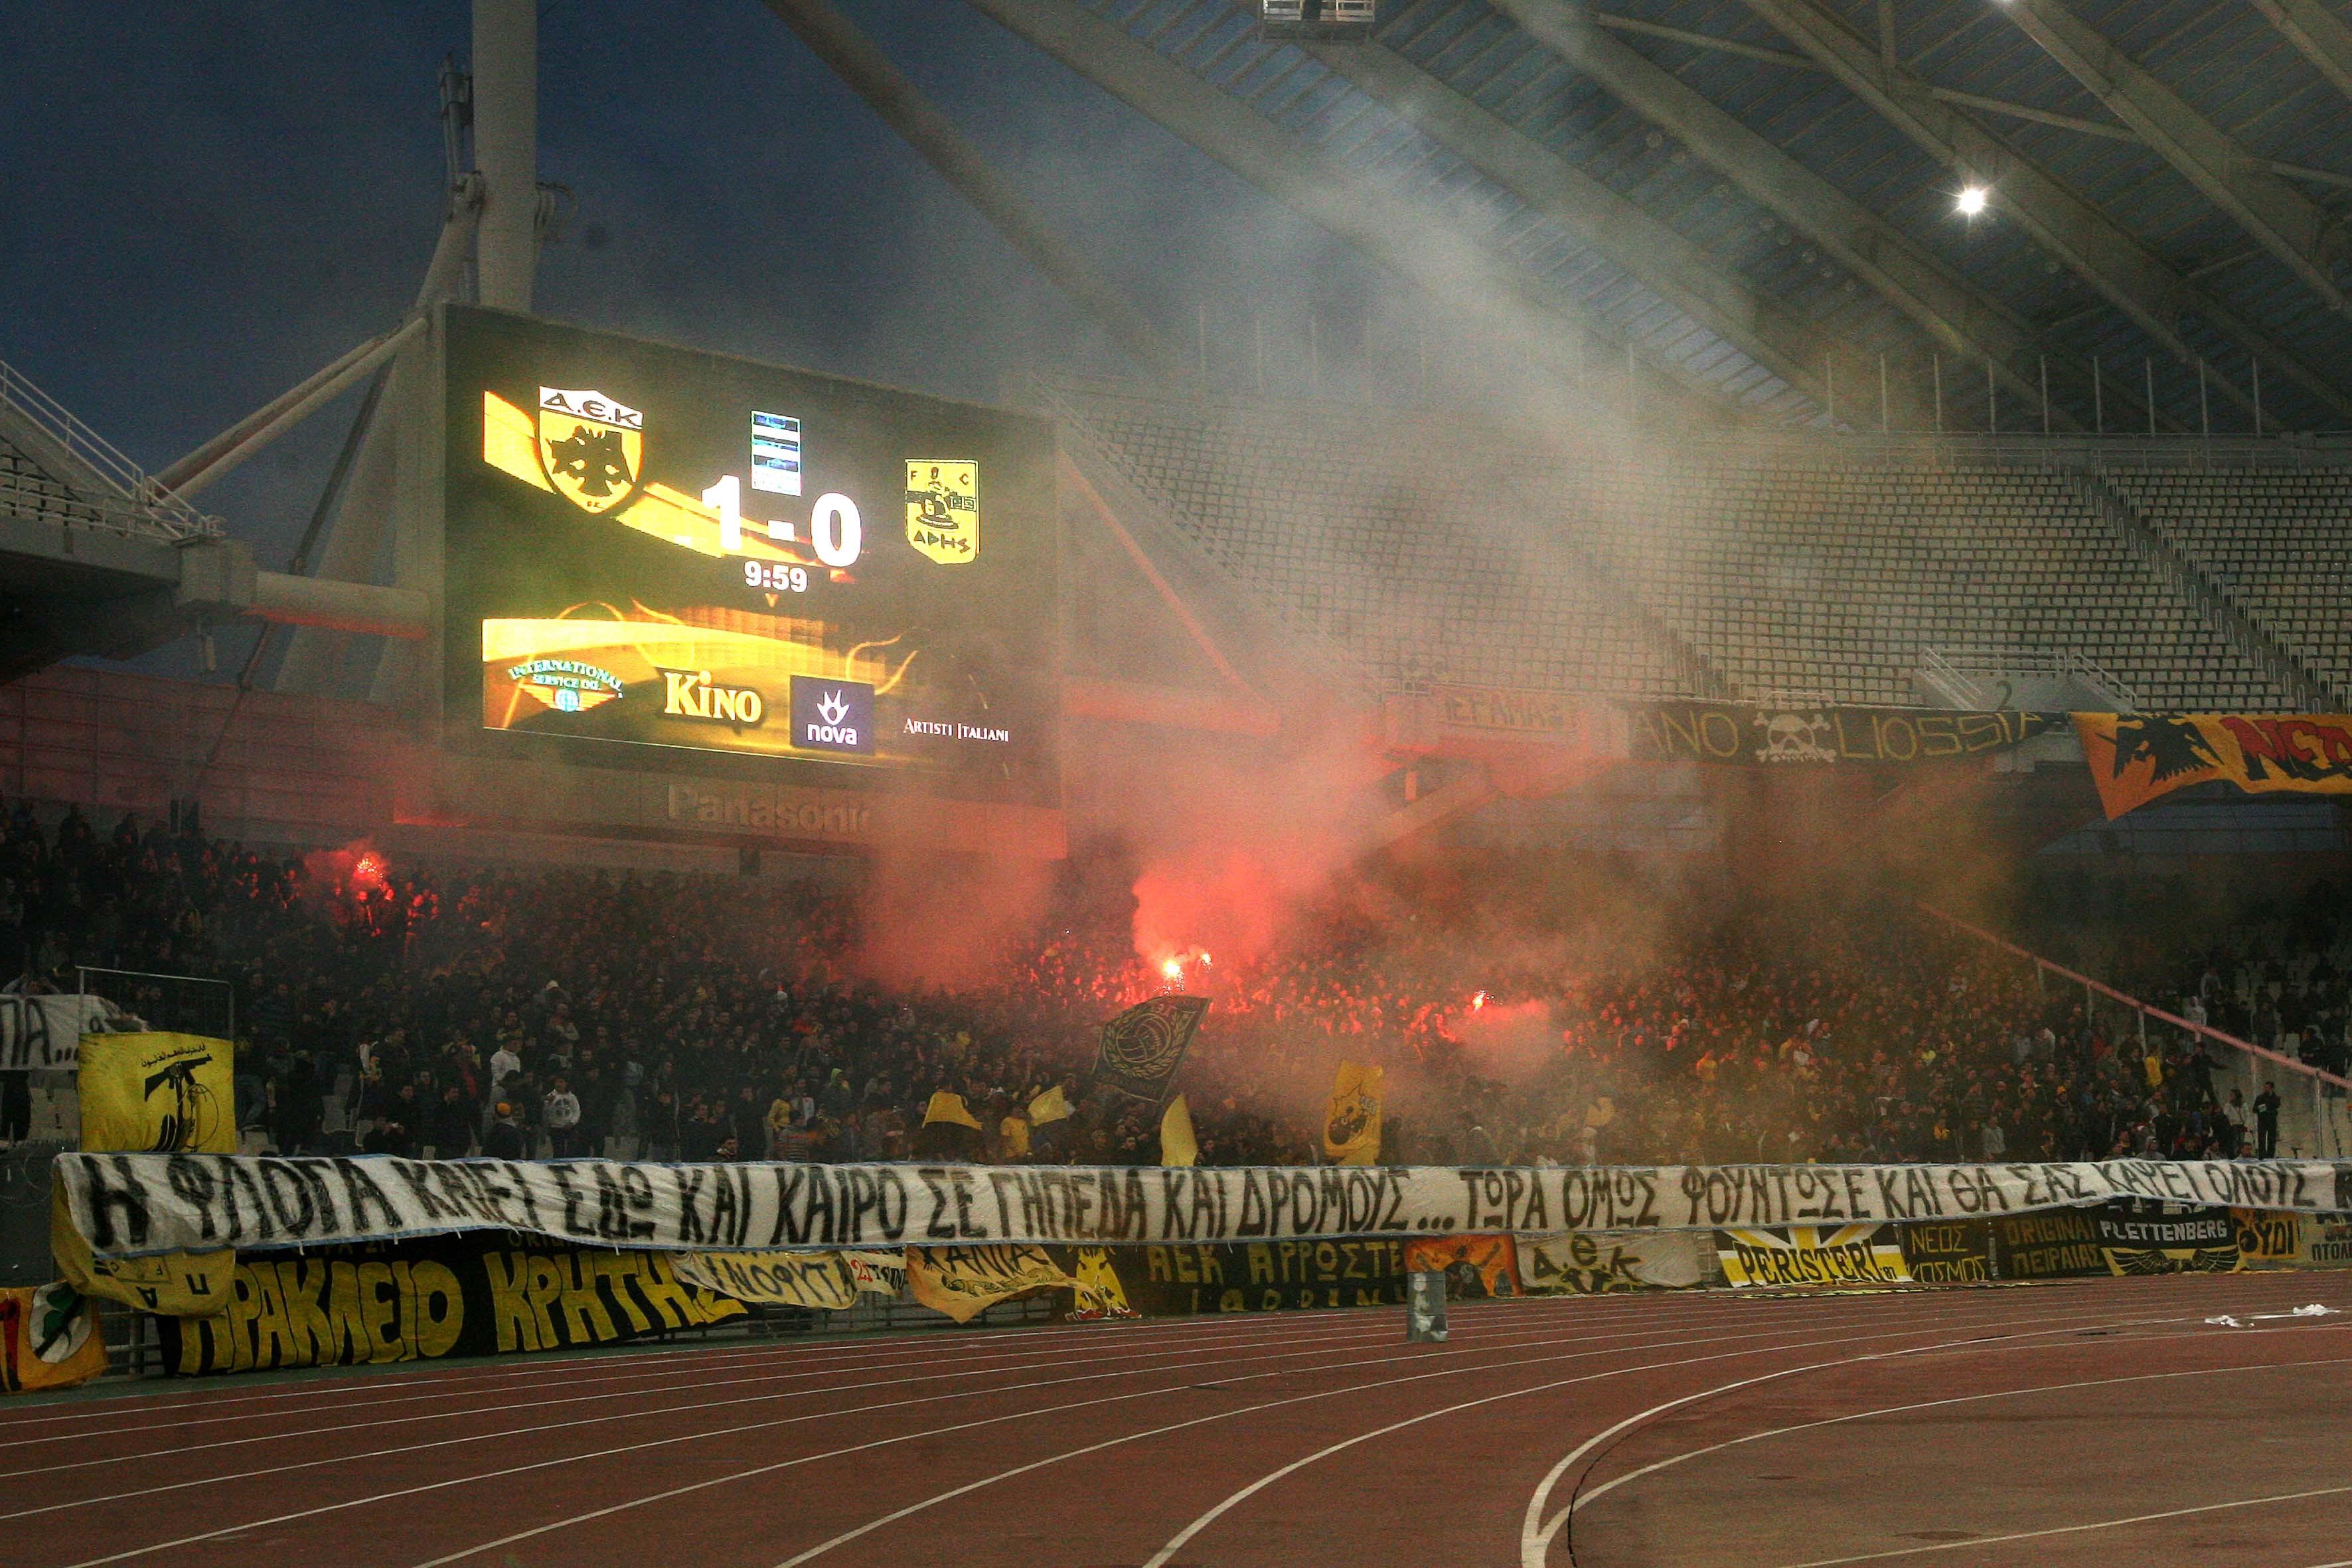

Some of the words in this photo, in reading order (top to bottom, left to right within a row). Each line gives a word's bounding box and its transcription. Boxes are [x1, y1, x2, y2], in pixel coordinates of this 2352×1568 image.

[744, 560, 809, 593] 9:59
[807, 723, 858, 745] nova
[675, 1165, 751, 1245] ΚΑΙ
[769, 1166, 907, 1245] ΚΑΙΡΟ
[915, 1168, 988, 1239] ΣΕ
[1161, 1169, 1227, 1239] ΚΑΙ
[1873, 1167, 1942, 1220] ΚΑΙ
[1948, 1167, 2009, 1213] ΘΑ
[2100, 1219, 2227, 1242] PLETTENBERG
[1733, 1239, 1885, 1285] PERISTERI
